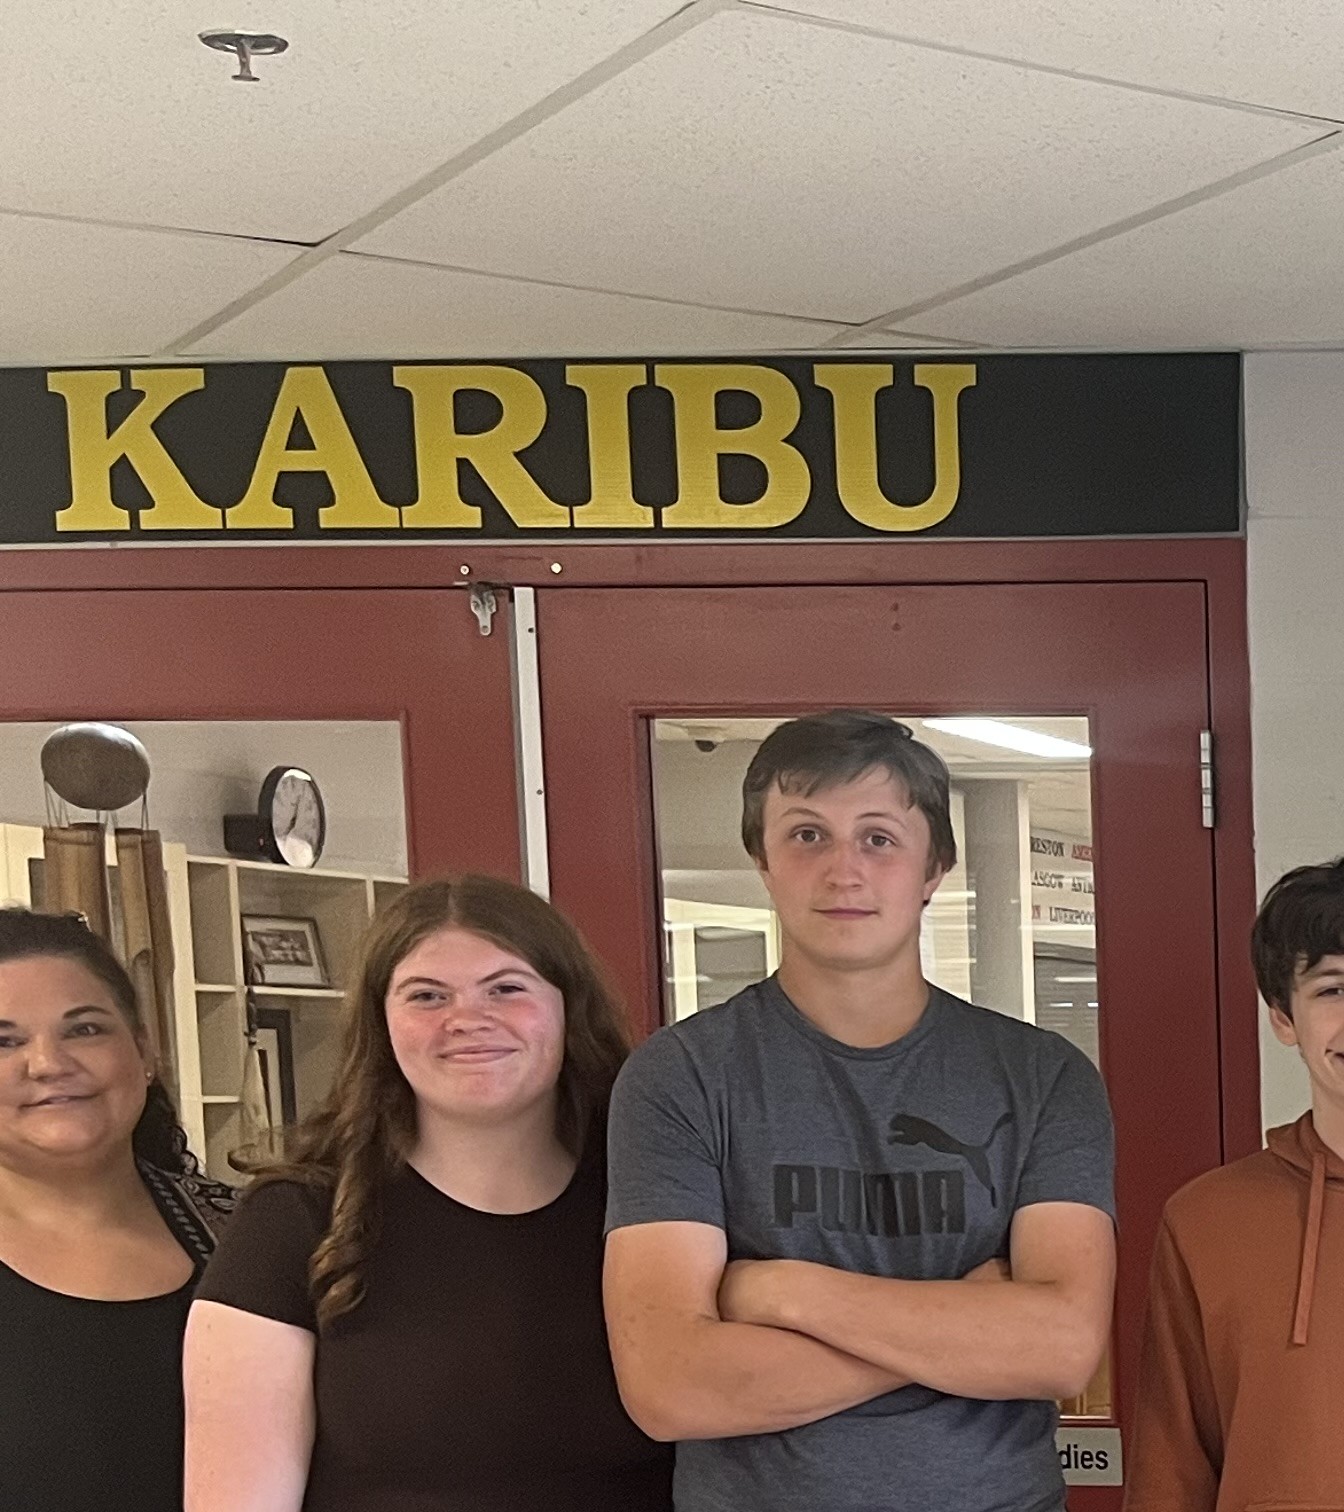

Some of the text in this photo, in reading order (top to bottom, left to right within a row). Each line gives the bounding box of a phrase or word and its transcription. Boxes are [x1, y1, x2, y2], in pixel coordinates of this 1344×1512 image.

[47, 364, 977, 532] KARIBU
[773, 1164, 966, 1238] PUMA
[1058, 1444, 1109, 1470] dies
